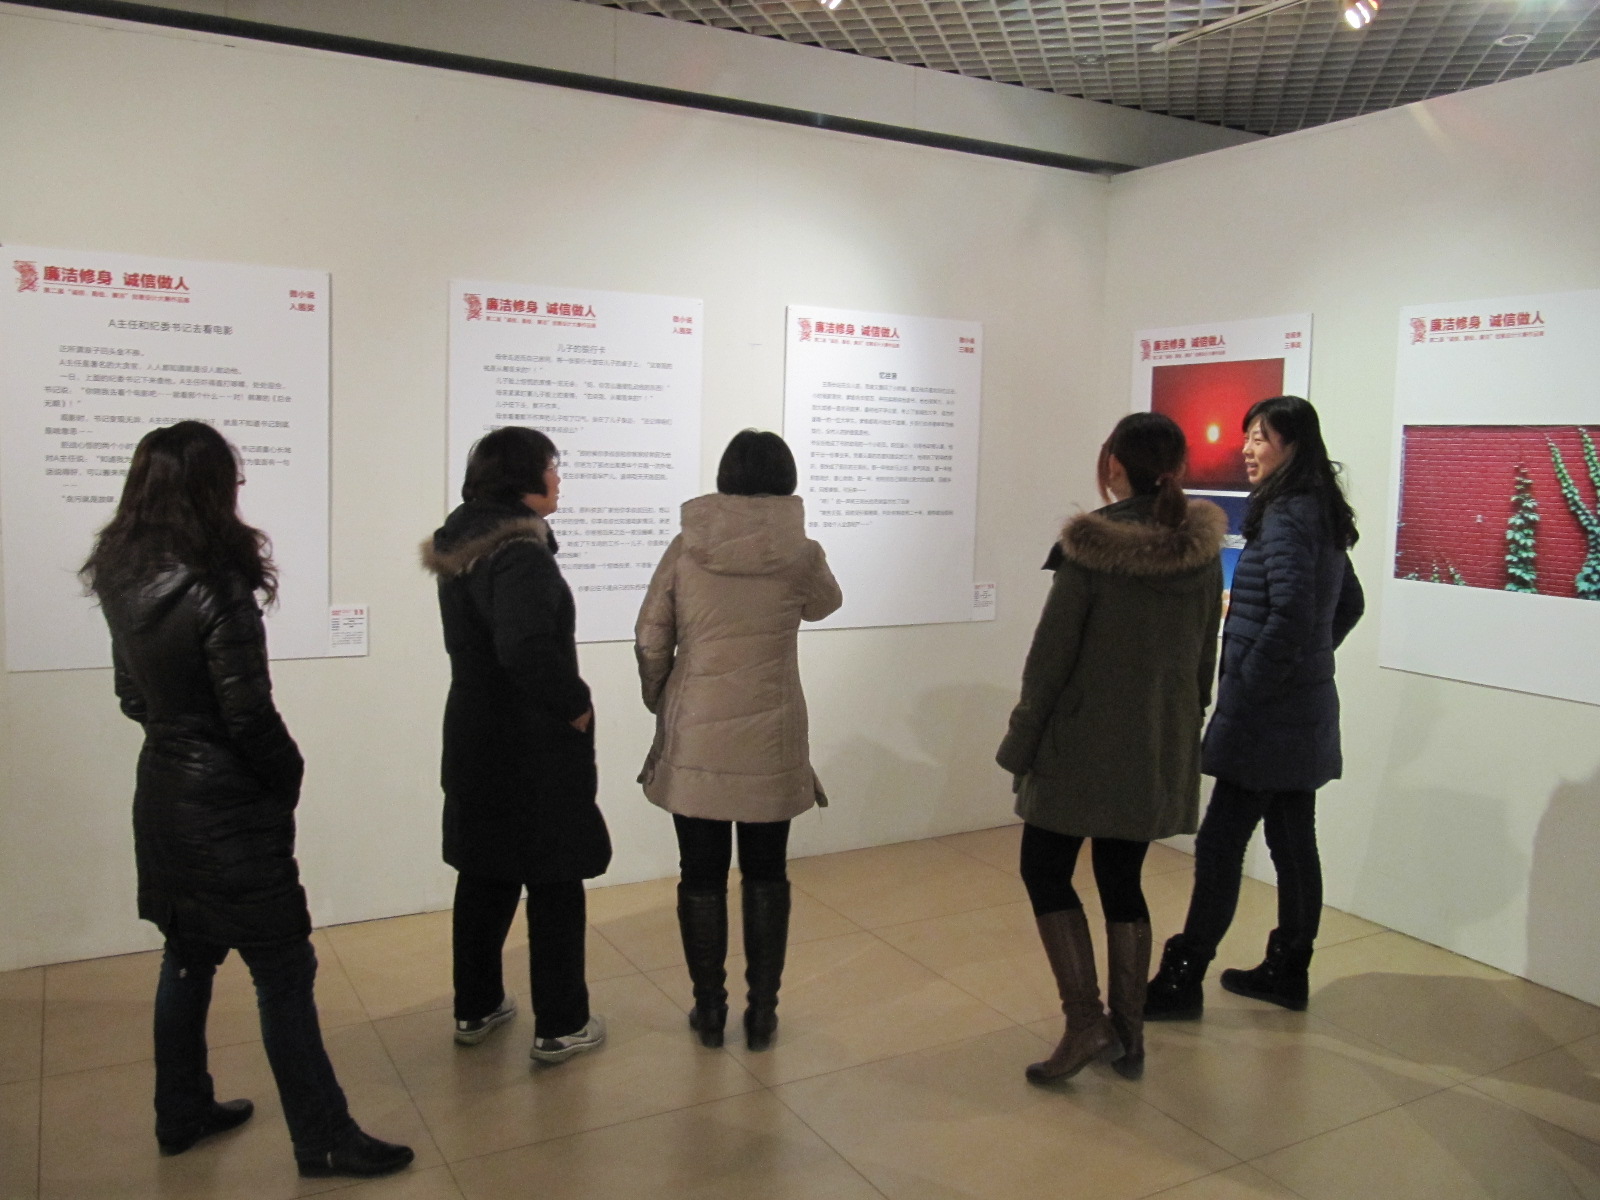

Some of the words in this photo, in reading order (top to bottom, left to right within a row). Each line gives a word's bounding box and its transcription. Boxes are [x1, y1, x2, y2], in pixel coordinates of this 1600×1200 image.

[43, 265, 113, 286] 廉洁修身
[123, 271, 190, 291] 诚信做人
[288, 302, 316, 313] 入围奖
[486, 297, 539, 314] 廉洁修身
[546, 301, 597, 318] 诚信做人
[107, 318, 234, 335] A主任和纪委书记去看电影
[1429, 315, 1482, 332] 廉洁修身
[1489, 310, 1544, 328] 诚信做人
[814, 321, 856, 336] 廉洁修身
[861, 325, 900, 339] 诚信做人
[557, 343, 607, 355] 儿子的银行卡
[1153, 338, 1186, 351] 廉洁修身
[1191, 335, 1226, 348] 诚信做人
